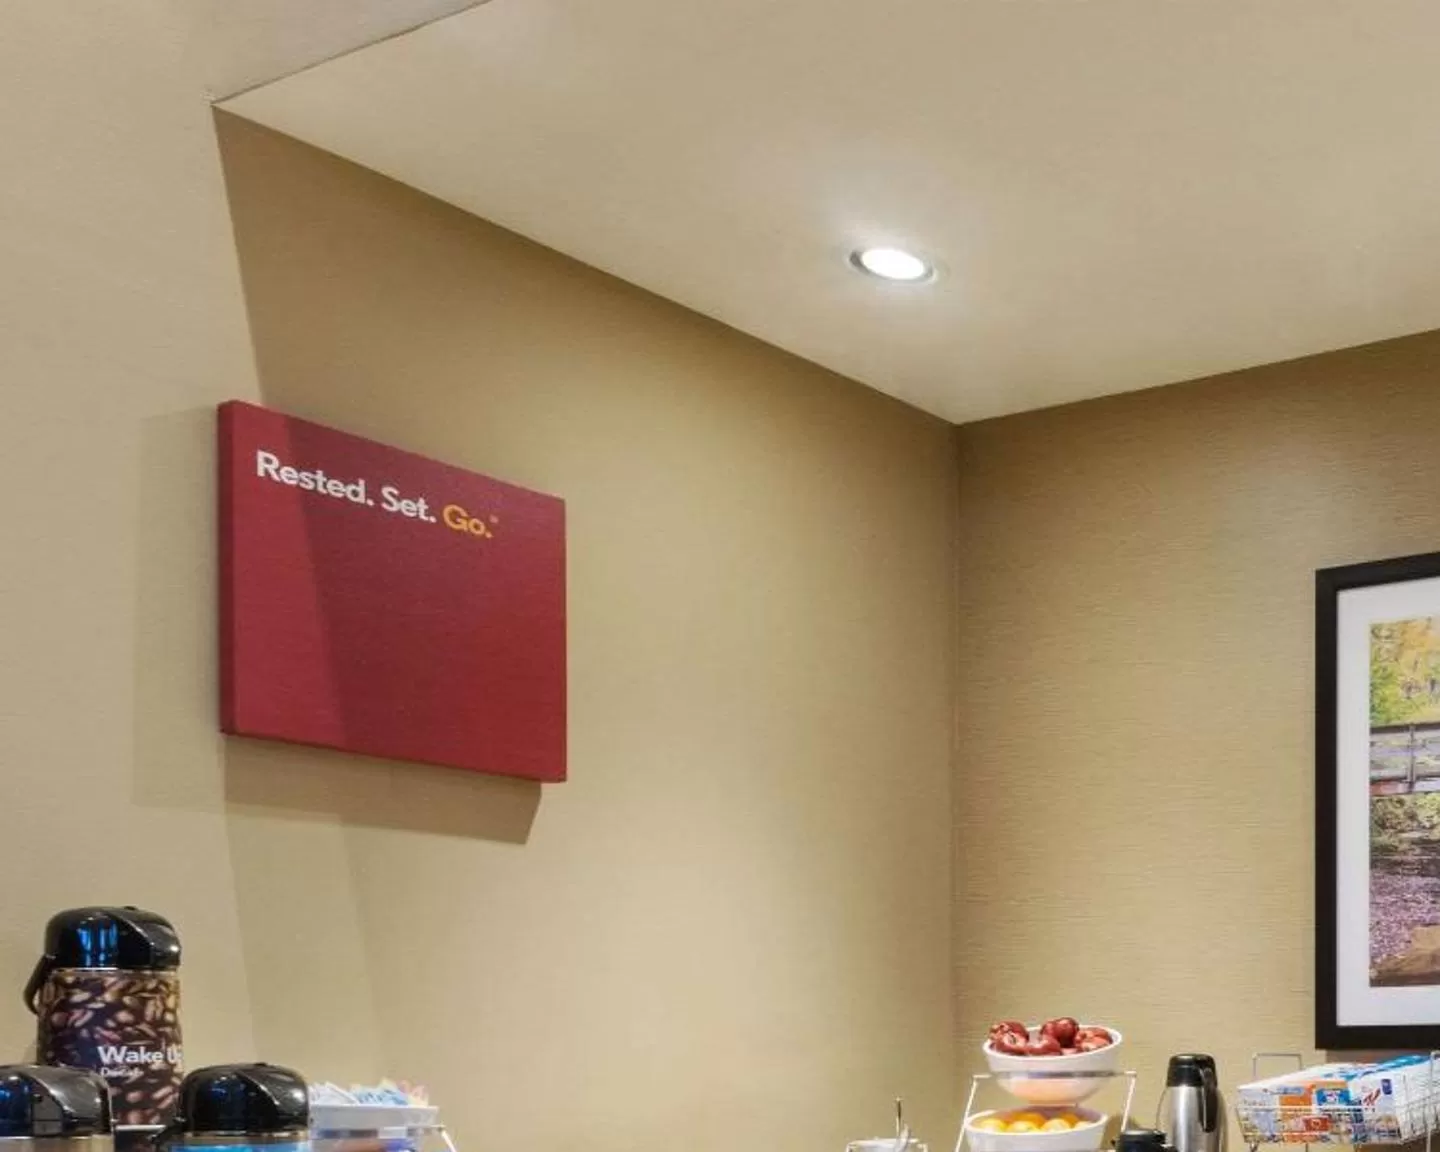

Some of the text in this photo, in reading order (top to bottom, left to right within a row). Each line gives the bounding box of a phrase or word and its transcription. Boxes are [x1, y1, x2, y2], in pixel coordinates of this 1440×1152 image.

[256, 450, 374, 506] Rested.
[380, 486, 437, 523] Set.
[97, 1045, 164, 1065] Wake
